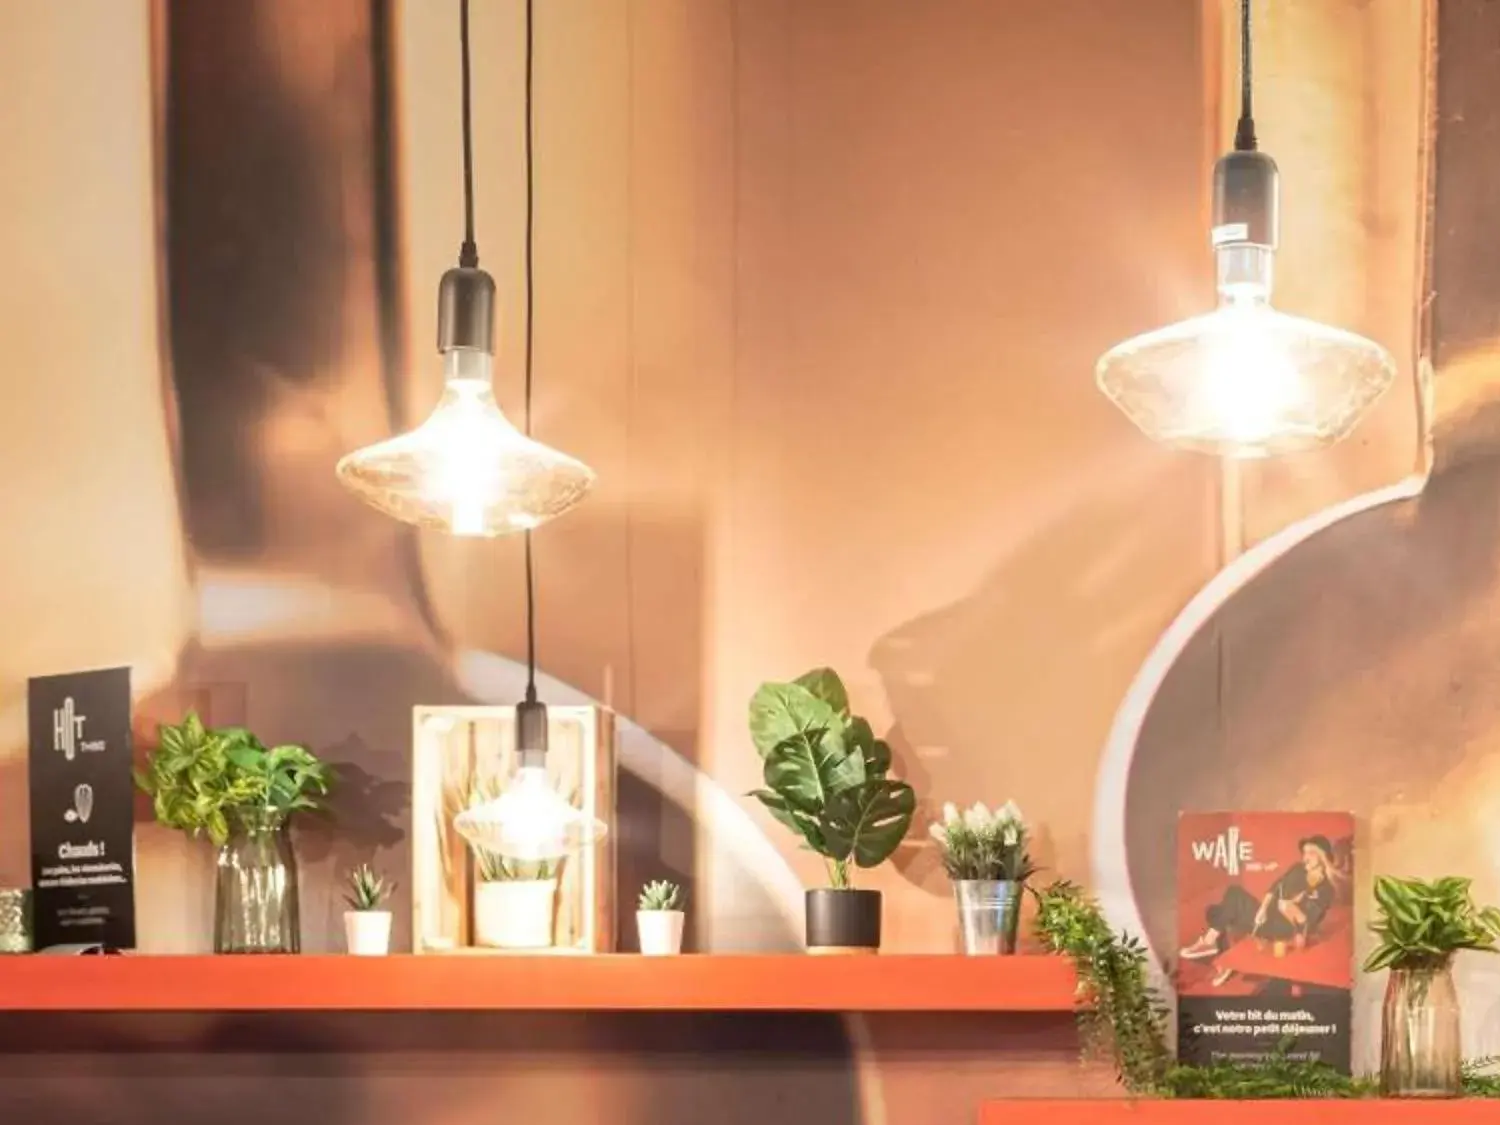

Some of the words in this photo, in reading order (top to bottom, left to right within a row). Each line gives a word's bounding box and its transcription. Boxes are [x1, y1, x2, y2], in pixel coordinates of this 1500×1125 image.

[1215, 1009, 1246, 1022] Votre
[1248, 1009, 1263, 1021] hit
[1264, 1009, 1278, 1022] du
[1280, 1009, 1316, 1023] matin,
[1222, 1025, 1252, 1035] notre
[1254, 1023, 1280, 1037] petit
[1281, 1022, 1330, 1037] déjeuner
